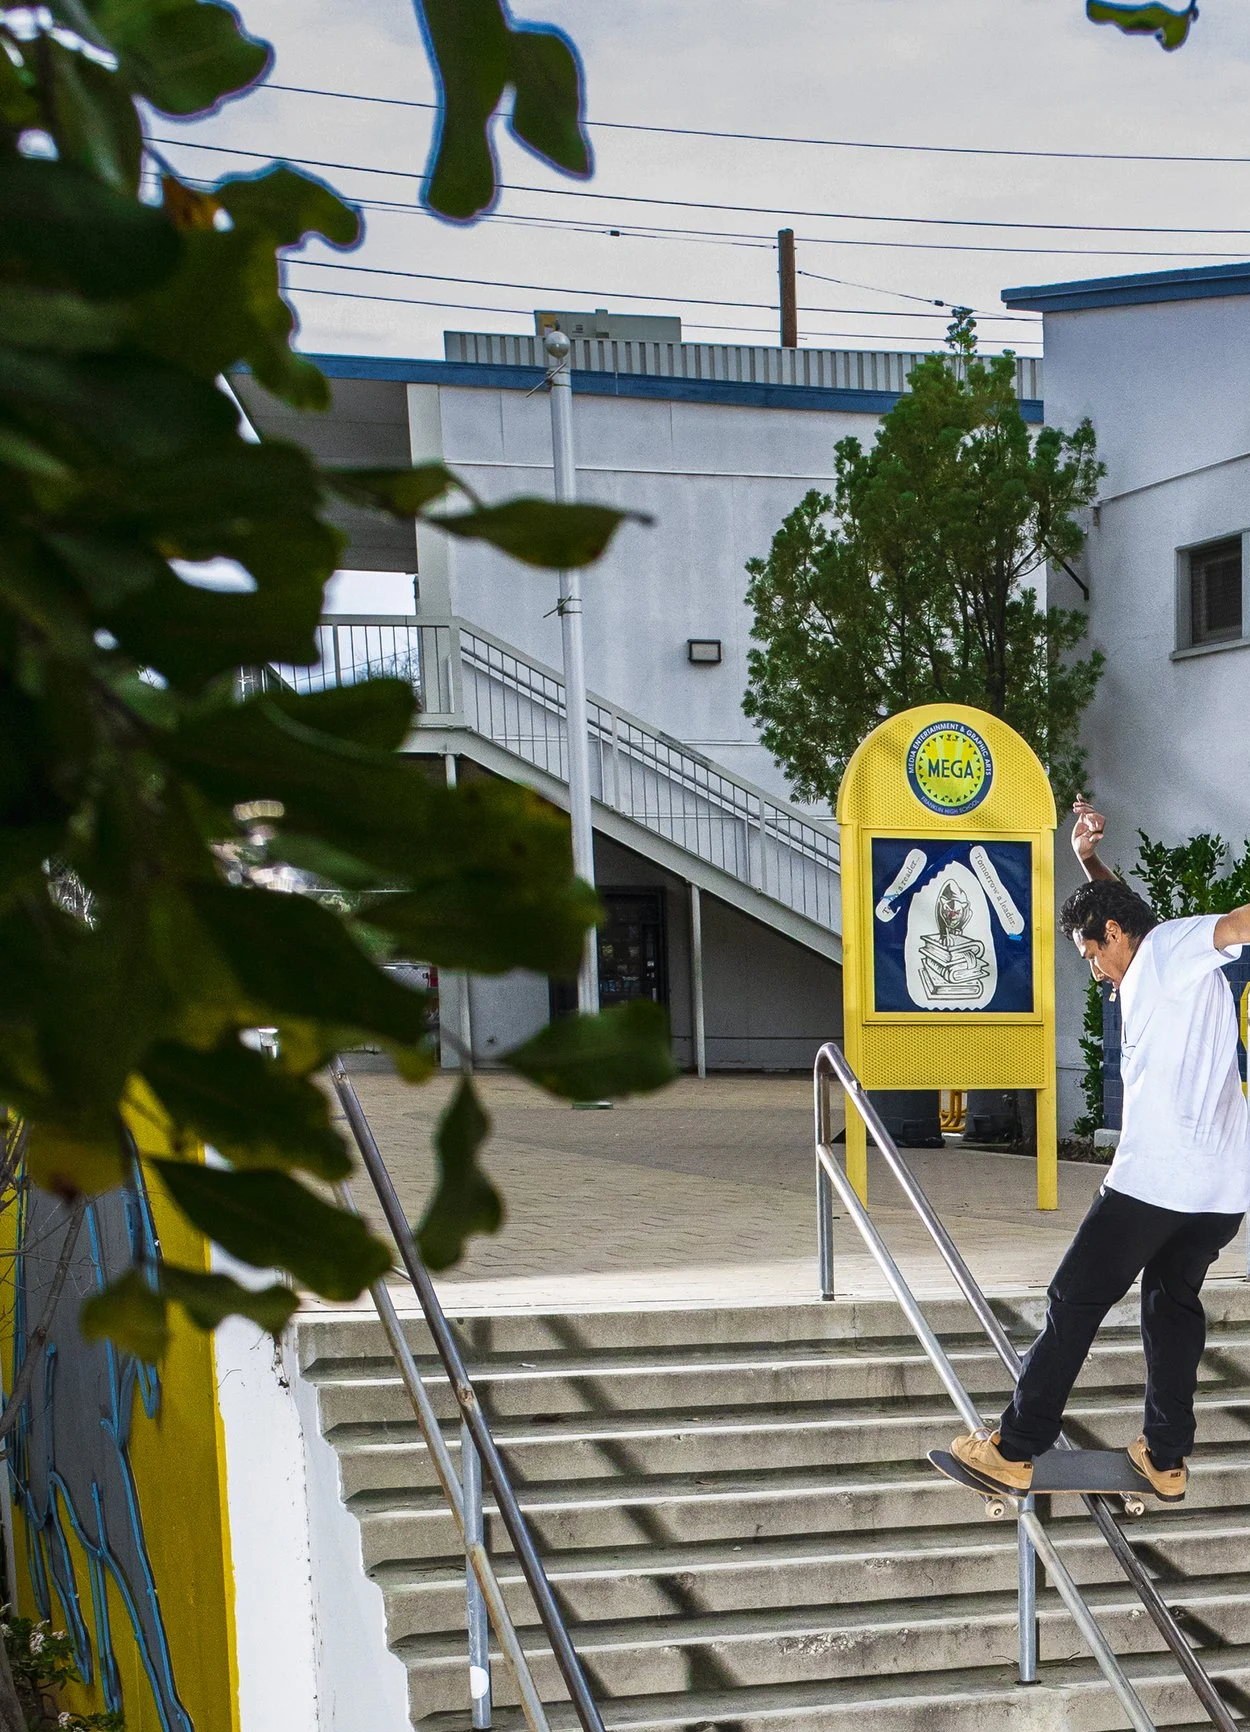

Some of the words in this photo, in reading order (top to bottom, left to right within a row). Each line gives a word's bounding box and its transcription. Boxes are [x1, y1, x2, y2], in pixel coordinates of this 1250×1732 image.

[908, 750, 916, 774] MEDIA
[912, 722, 959, 750] ENTERTAINMENT
[959, 725, 966, 733] &
[966, 729, 989, 757] GRAPHIC
[984, 758, 992, 776] ARTS
[928, 758, 974, 778] MEGA
[974, 852, 1000, 895] Tomorrow
[999, 900, 1016, 928] leader.
